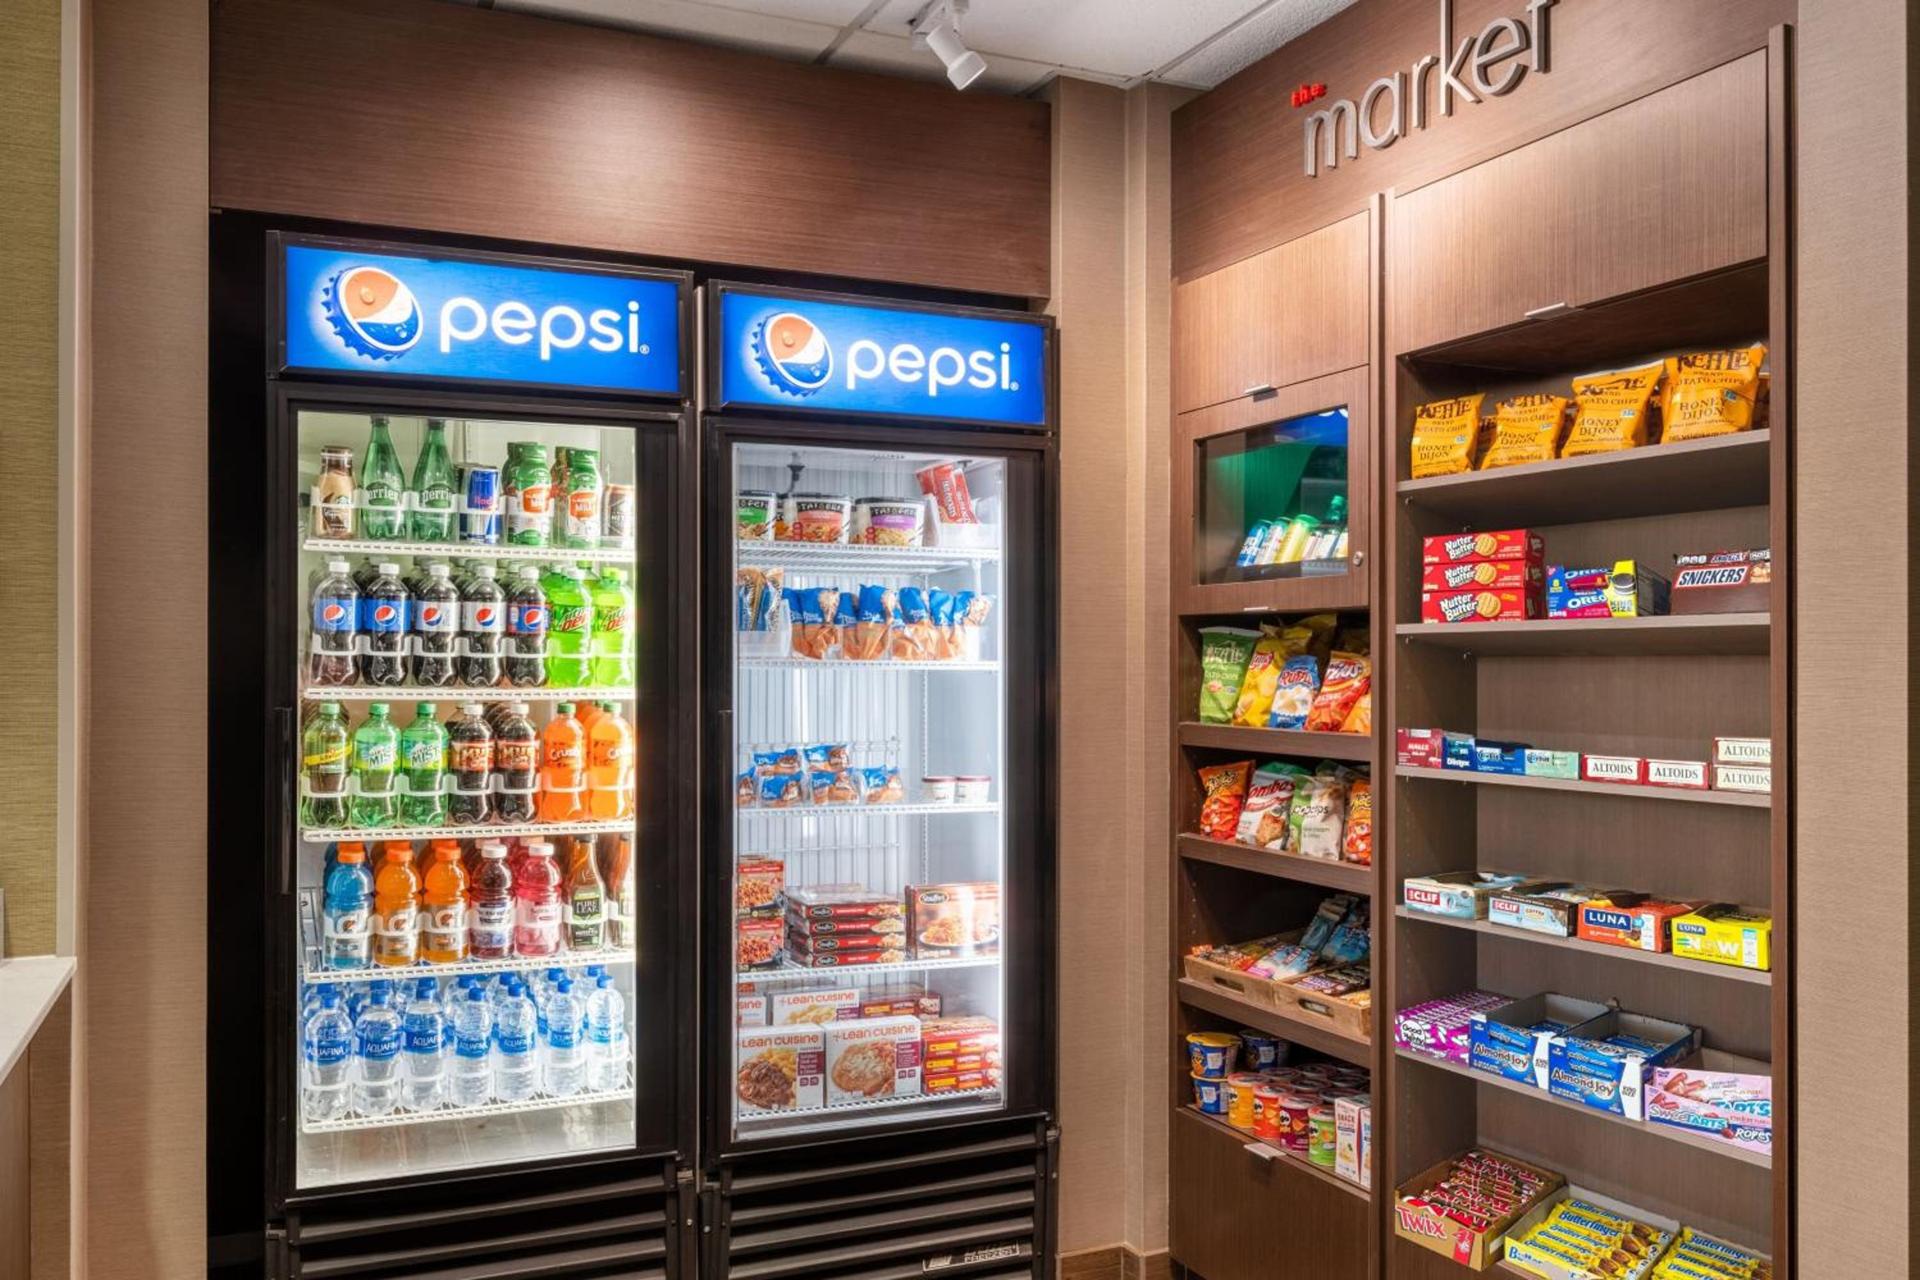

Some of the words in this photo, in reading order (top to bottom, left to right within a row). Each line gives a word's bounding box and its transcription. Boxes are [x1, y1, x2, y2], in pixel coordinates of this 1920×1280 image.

[1291, 82, 1326, 107] the
[1304, 0, 1552, 177] market
[440, 300, 641, 360] pepsi
[846, 342, 1010, 396] pepsi
[1680, 397, 1725, 411] HONEY
[1683, 407, 1724, 421] DIJON
[1580, 426, 1616, 436] DIJON
[1445, 536, 1473, 552] Nutter
[1449, 542, 1476, 560] Butter
[1445, 564, 1473, 581] Nutter
[1448, 570, 1476, 588] Butter
[1679, 568, 1746, 585] SNICKERS
[1440, 593, 1474, 611] Nutter
[1567, 595, 1607, 609] OREO
[1446, 601, 1477, 621] Butter
[369, 752, 393, 766] MIS
[1724, 746, 1770, 757] ALTOIDS
[1592, 762, 1633, 774] ALTOIDS
[1654, 767, 1698, 779] ALTOIDS
[1723, 772, 1770, 785] ALTOIDS
[1414, 890, 1438, 903] CLIF
[1498, 902, 1519, 912] CLIF
[1589, 912, 1627, 926] LUNA
[1678, 924, 1704, 933] LUNA
[1473, 1042, 1510, 1063] Almond
[1511, 1052, 1529, 1067] Joy
[1552, 1068, 1594, 1090] Almond
[1595, 1080, 1613, 1097] Joy
[1559, 1210, 1621, 1237] Butterfinger
